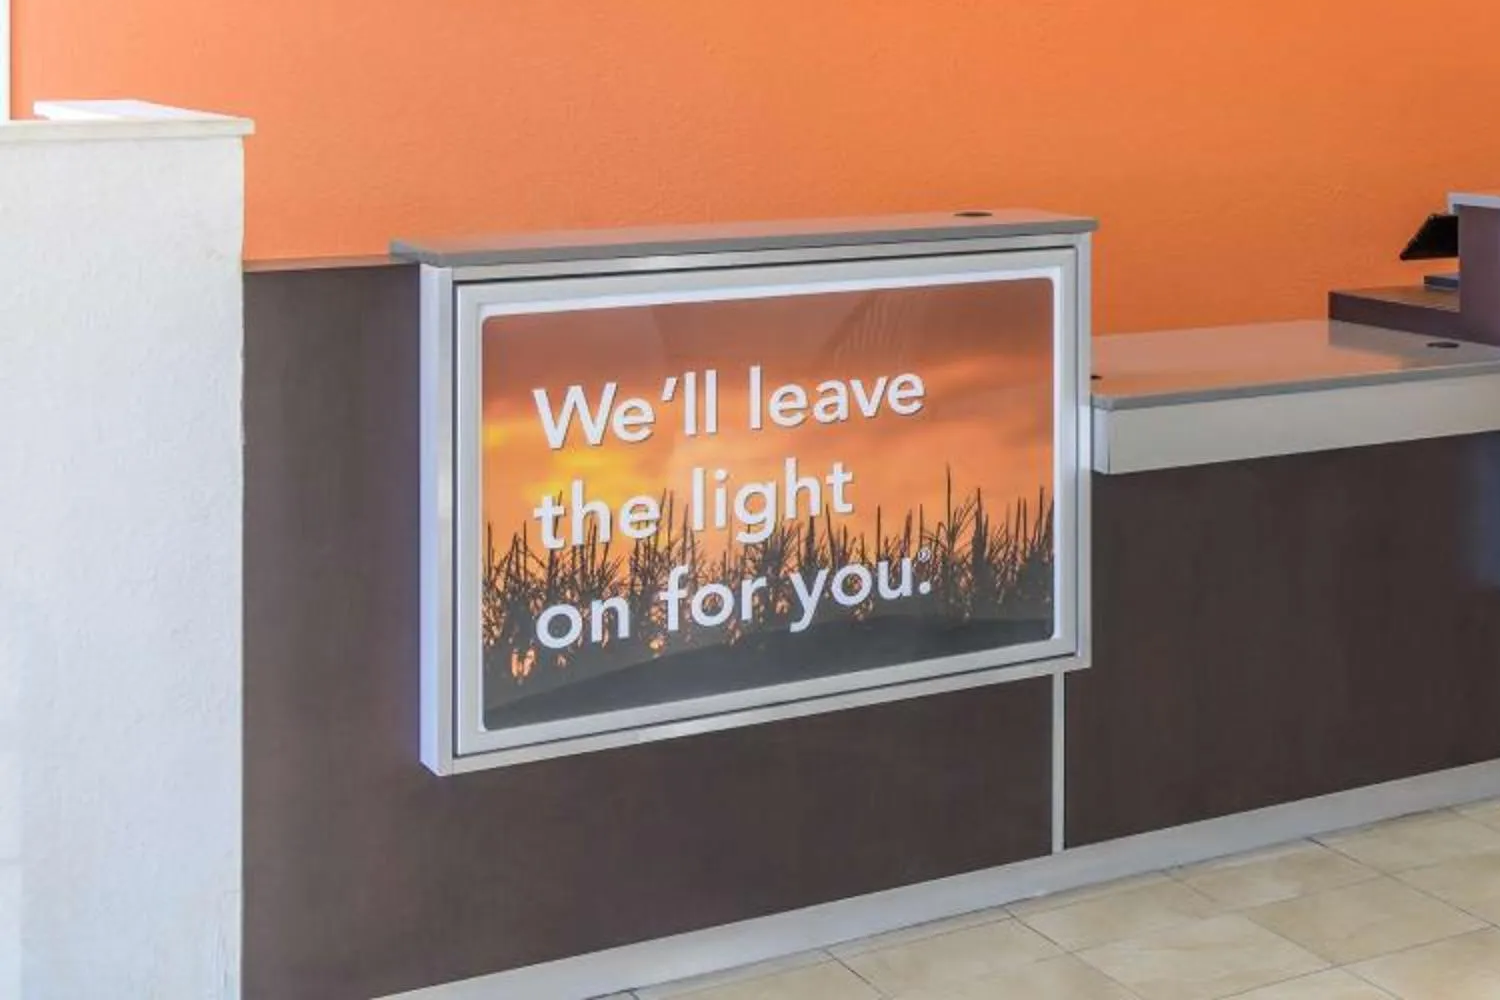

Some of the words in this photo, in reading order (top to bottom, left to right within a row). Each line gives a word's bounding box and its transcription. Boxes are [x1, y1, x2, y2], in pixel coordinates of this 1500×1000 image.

[532, 368, 718, 449] We'll
[749, 366, 925, 430] leave
[533, 480, 660, 550] the
[692, 458, 853, 543] light
[536, 595, 631, 649] on
[660, 566, 772, 632] for
